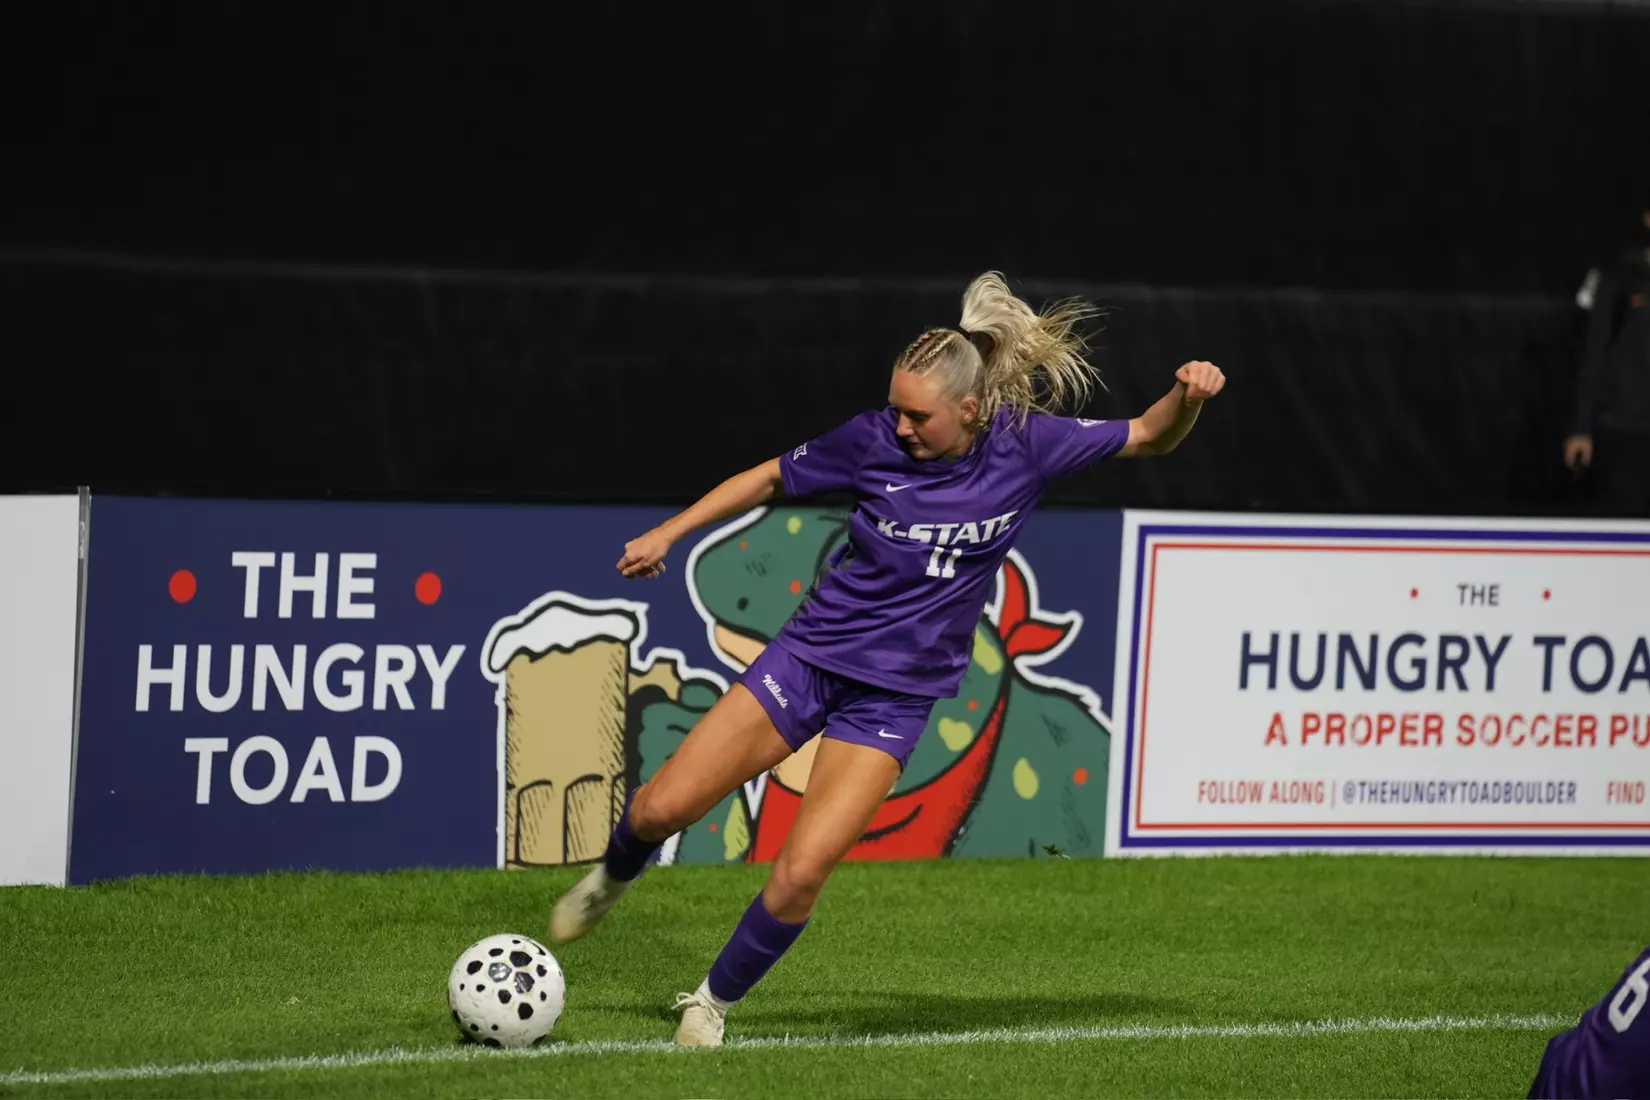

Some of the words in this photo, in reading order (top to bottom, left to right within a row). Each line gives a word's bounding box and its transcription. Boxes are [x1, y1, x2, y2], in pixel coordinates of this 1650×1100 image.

[877, 510, 1019, 545] K-STATE
[925, 546, 962, 578] 11
[232, 552, 377, 619] THE
[1457, 584, 1500, 606] THE
[135, 643, 466, 712] HUNGRY
[1238, 632, 1512, 692] HUNGRY
[762, 673, 788, 708] Wildcats
[1264, 712, 1288, 747] A
[1301, 713, 1444, 747] PROPER
[1456, 714, 1598, 747] SOCCER
[184, 735, 403, 805] TOAD
[1198, 780, 1264, 805] FOLLOW
[1268, 780, 1325, 805] ALONG
[1343, 780, 1577, 805] @THEHUNGRYTOADBOULDER
[1606, 780, 1646, 805] FIND
[1608, 957, 1650, 1033] 6
